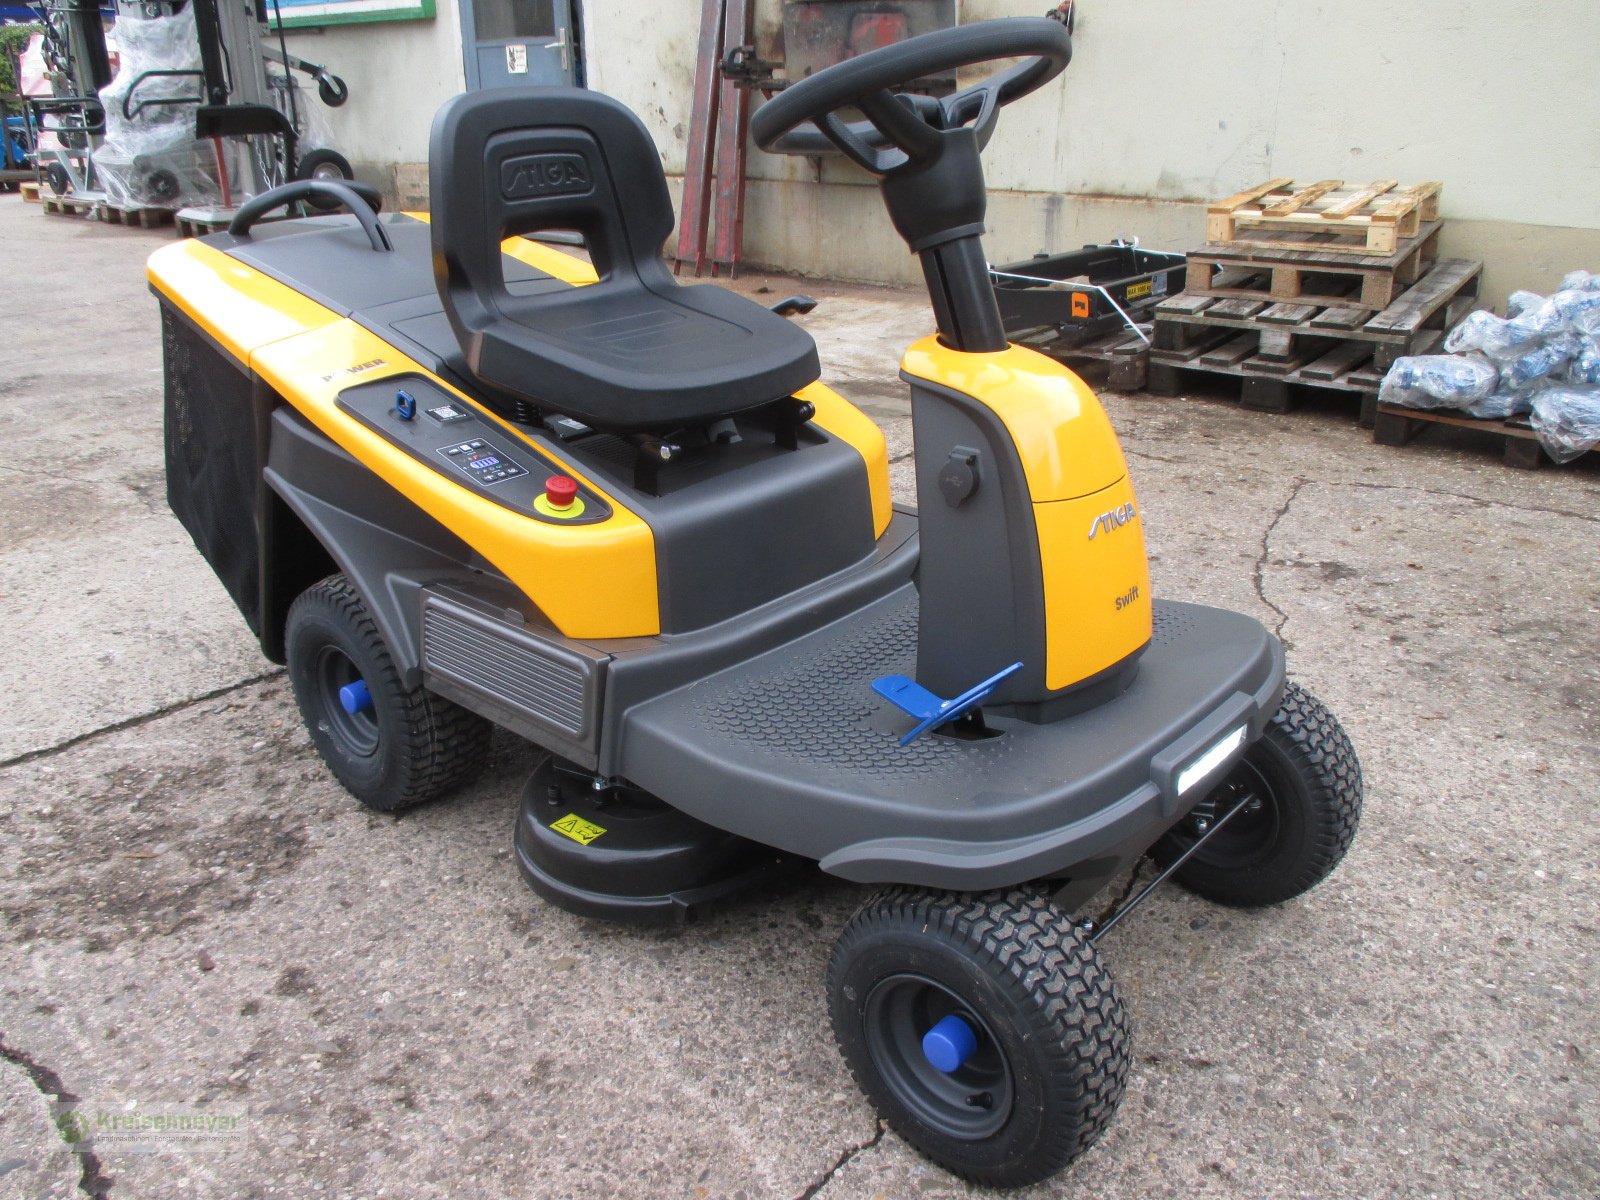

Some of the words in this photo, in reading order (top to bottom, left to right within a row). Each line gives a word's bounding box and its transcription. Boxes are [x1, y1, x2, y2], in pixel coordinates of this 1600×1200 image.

[507, 161, 587, 192] STIGA
[321, 359, 385, 382] PWER
[1088, 502, 1137, 541] STIGA
